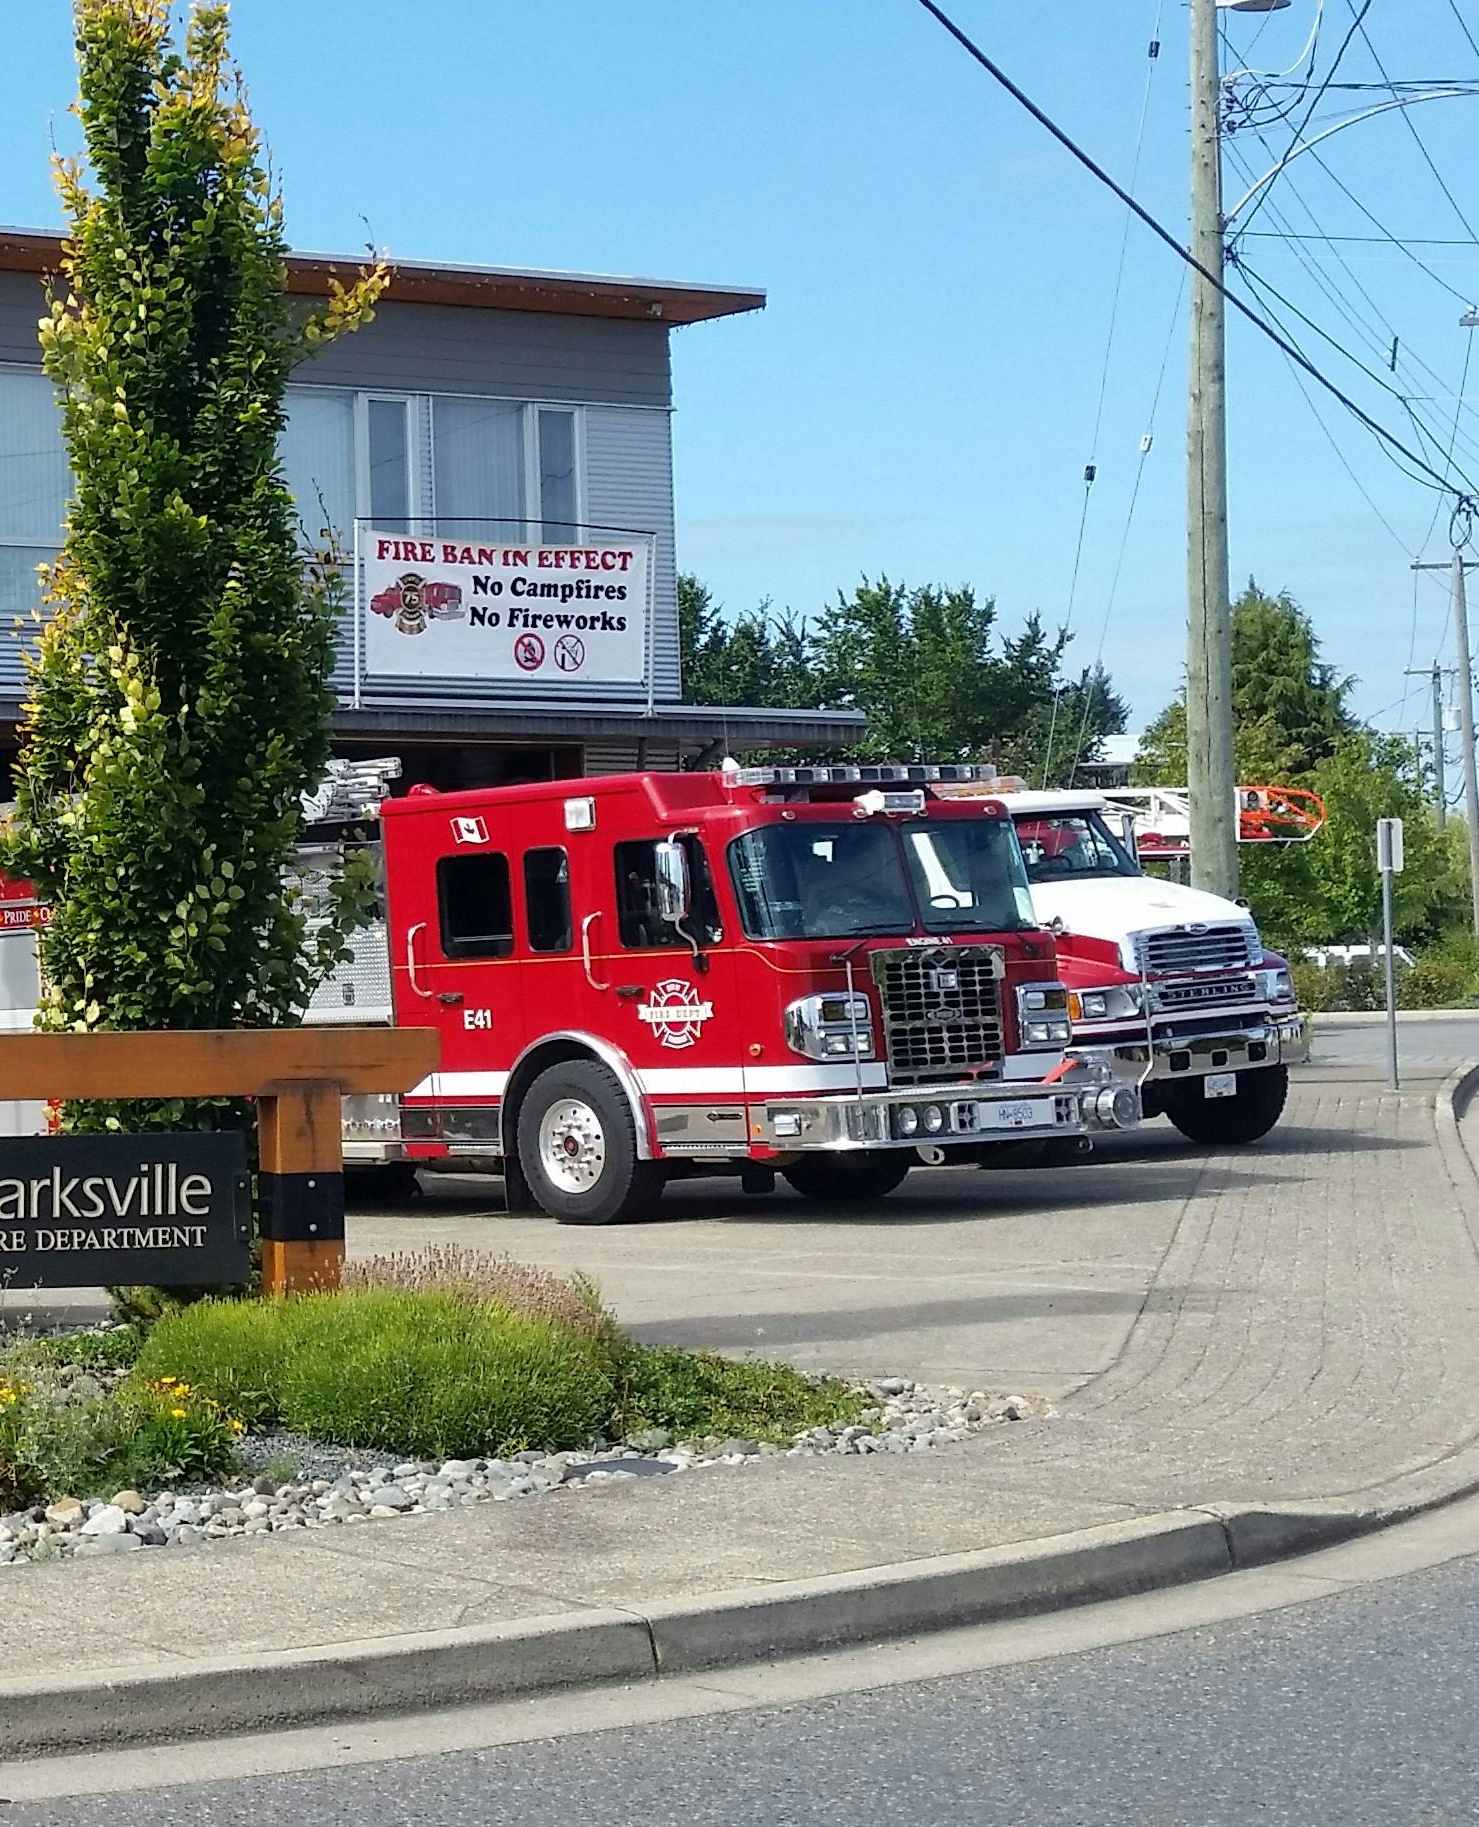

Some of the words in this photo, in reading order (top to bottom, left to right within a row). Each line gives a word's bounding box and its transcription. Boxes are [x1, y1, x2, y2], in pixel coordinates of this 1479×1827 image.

[377, 540, 435, 563] FIRE
[442, 544, 497, 566] BAN
[502, 549, 532, 567] IN
[537, 550, 633, 571] EFFECT
[404, 591, 420, 604] 75
[472, 575, 503, 596] No
[510, 576, 627, 603] Campfires
[469, 606, 500, 627] No
[507, 607, 627, 631] Fireworks
[4, 910, 31, 924] PRIDE
[1167, 983, 1251, 999] STERLING
[464, 1009, 492, 1029] E41
[35, 1226, 207, 1250] DEPARTMENT
